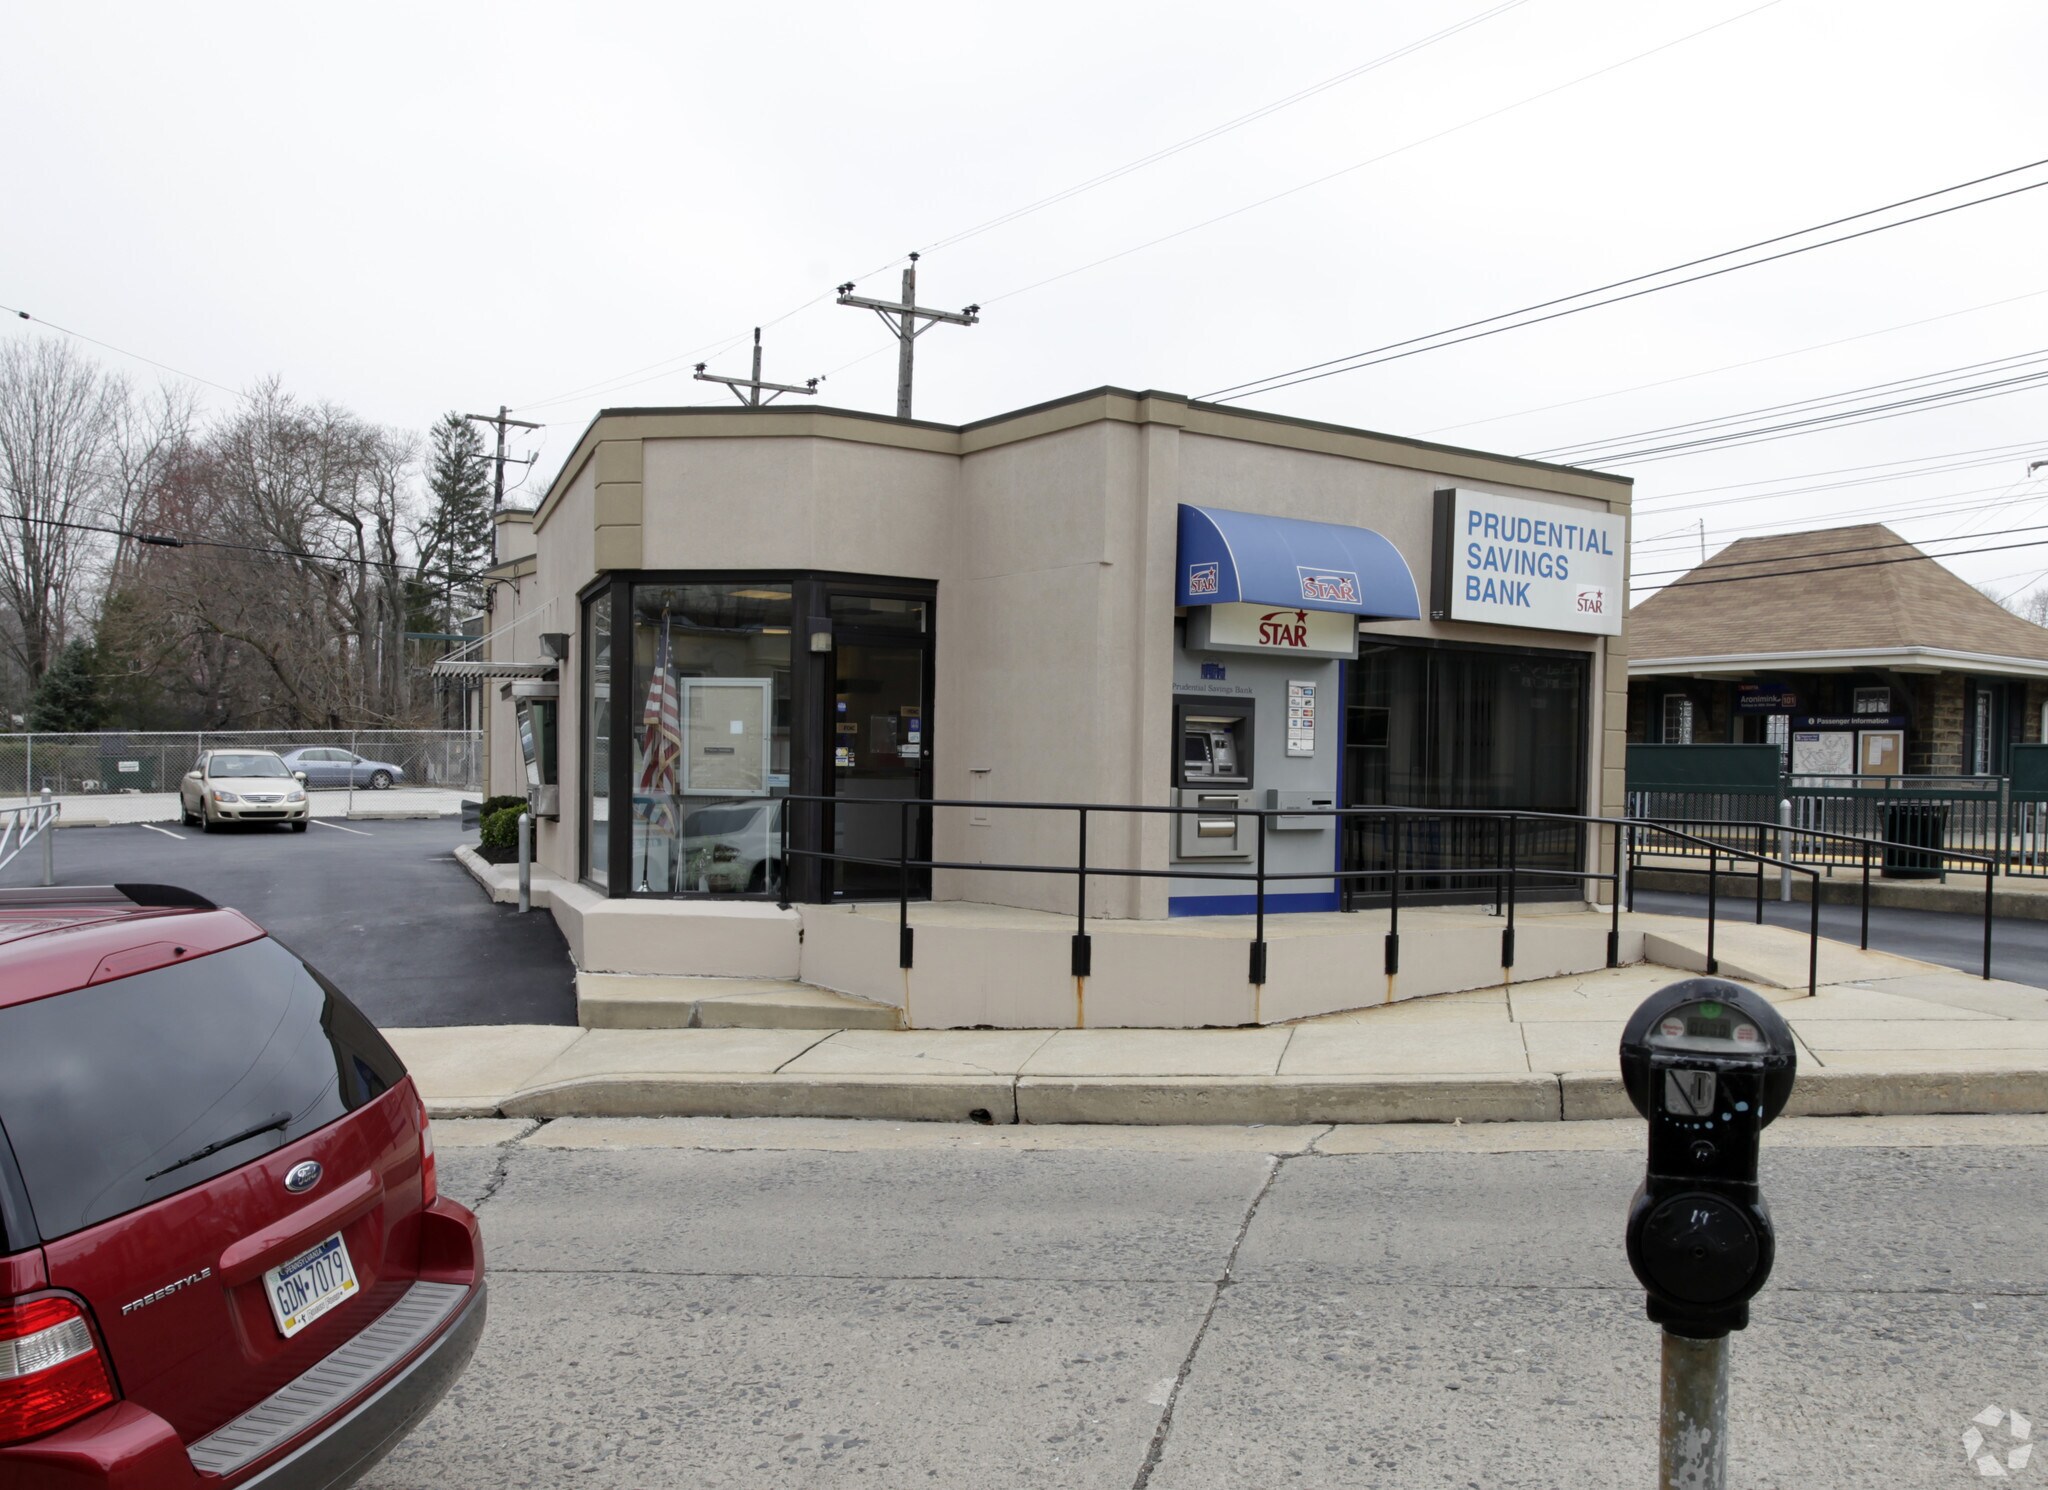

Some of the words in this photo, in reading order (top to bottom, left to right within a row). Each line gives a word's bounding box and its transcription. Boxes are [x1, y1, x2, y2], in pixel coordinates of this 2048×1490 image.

[1468, 510, 1613, 556] PRUDENTIAL
[1467, 542, 1568, 581] SAVINGS
[1191, 577, 1216, 593] STAR
[1303, 581, 1357, 602] STAR
[1466, 575, 1531, 608] BANK
[1577, 597, 1603, 614] STAR
[1259, 622, 1308, 647] STAR
[1172, 682, 1206, 692] Prudential
[1208, 685, 1233, 694] Savings
[1235, 686, 1253, 694] Bank
[1741, 695, 1777, 703] Aronimink
[1817, 717, 1850, 725] Passenger
[297, 1166, 317, 1186] Ford
[121, 1267, 212, 1316] FREESTYLE
